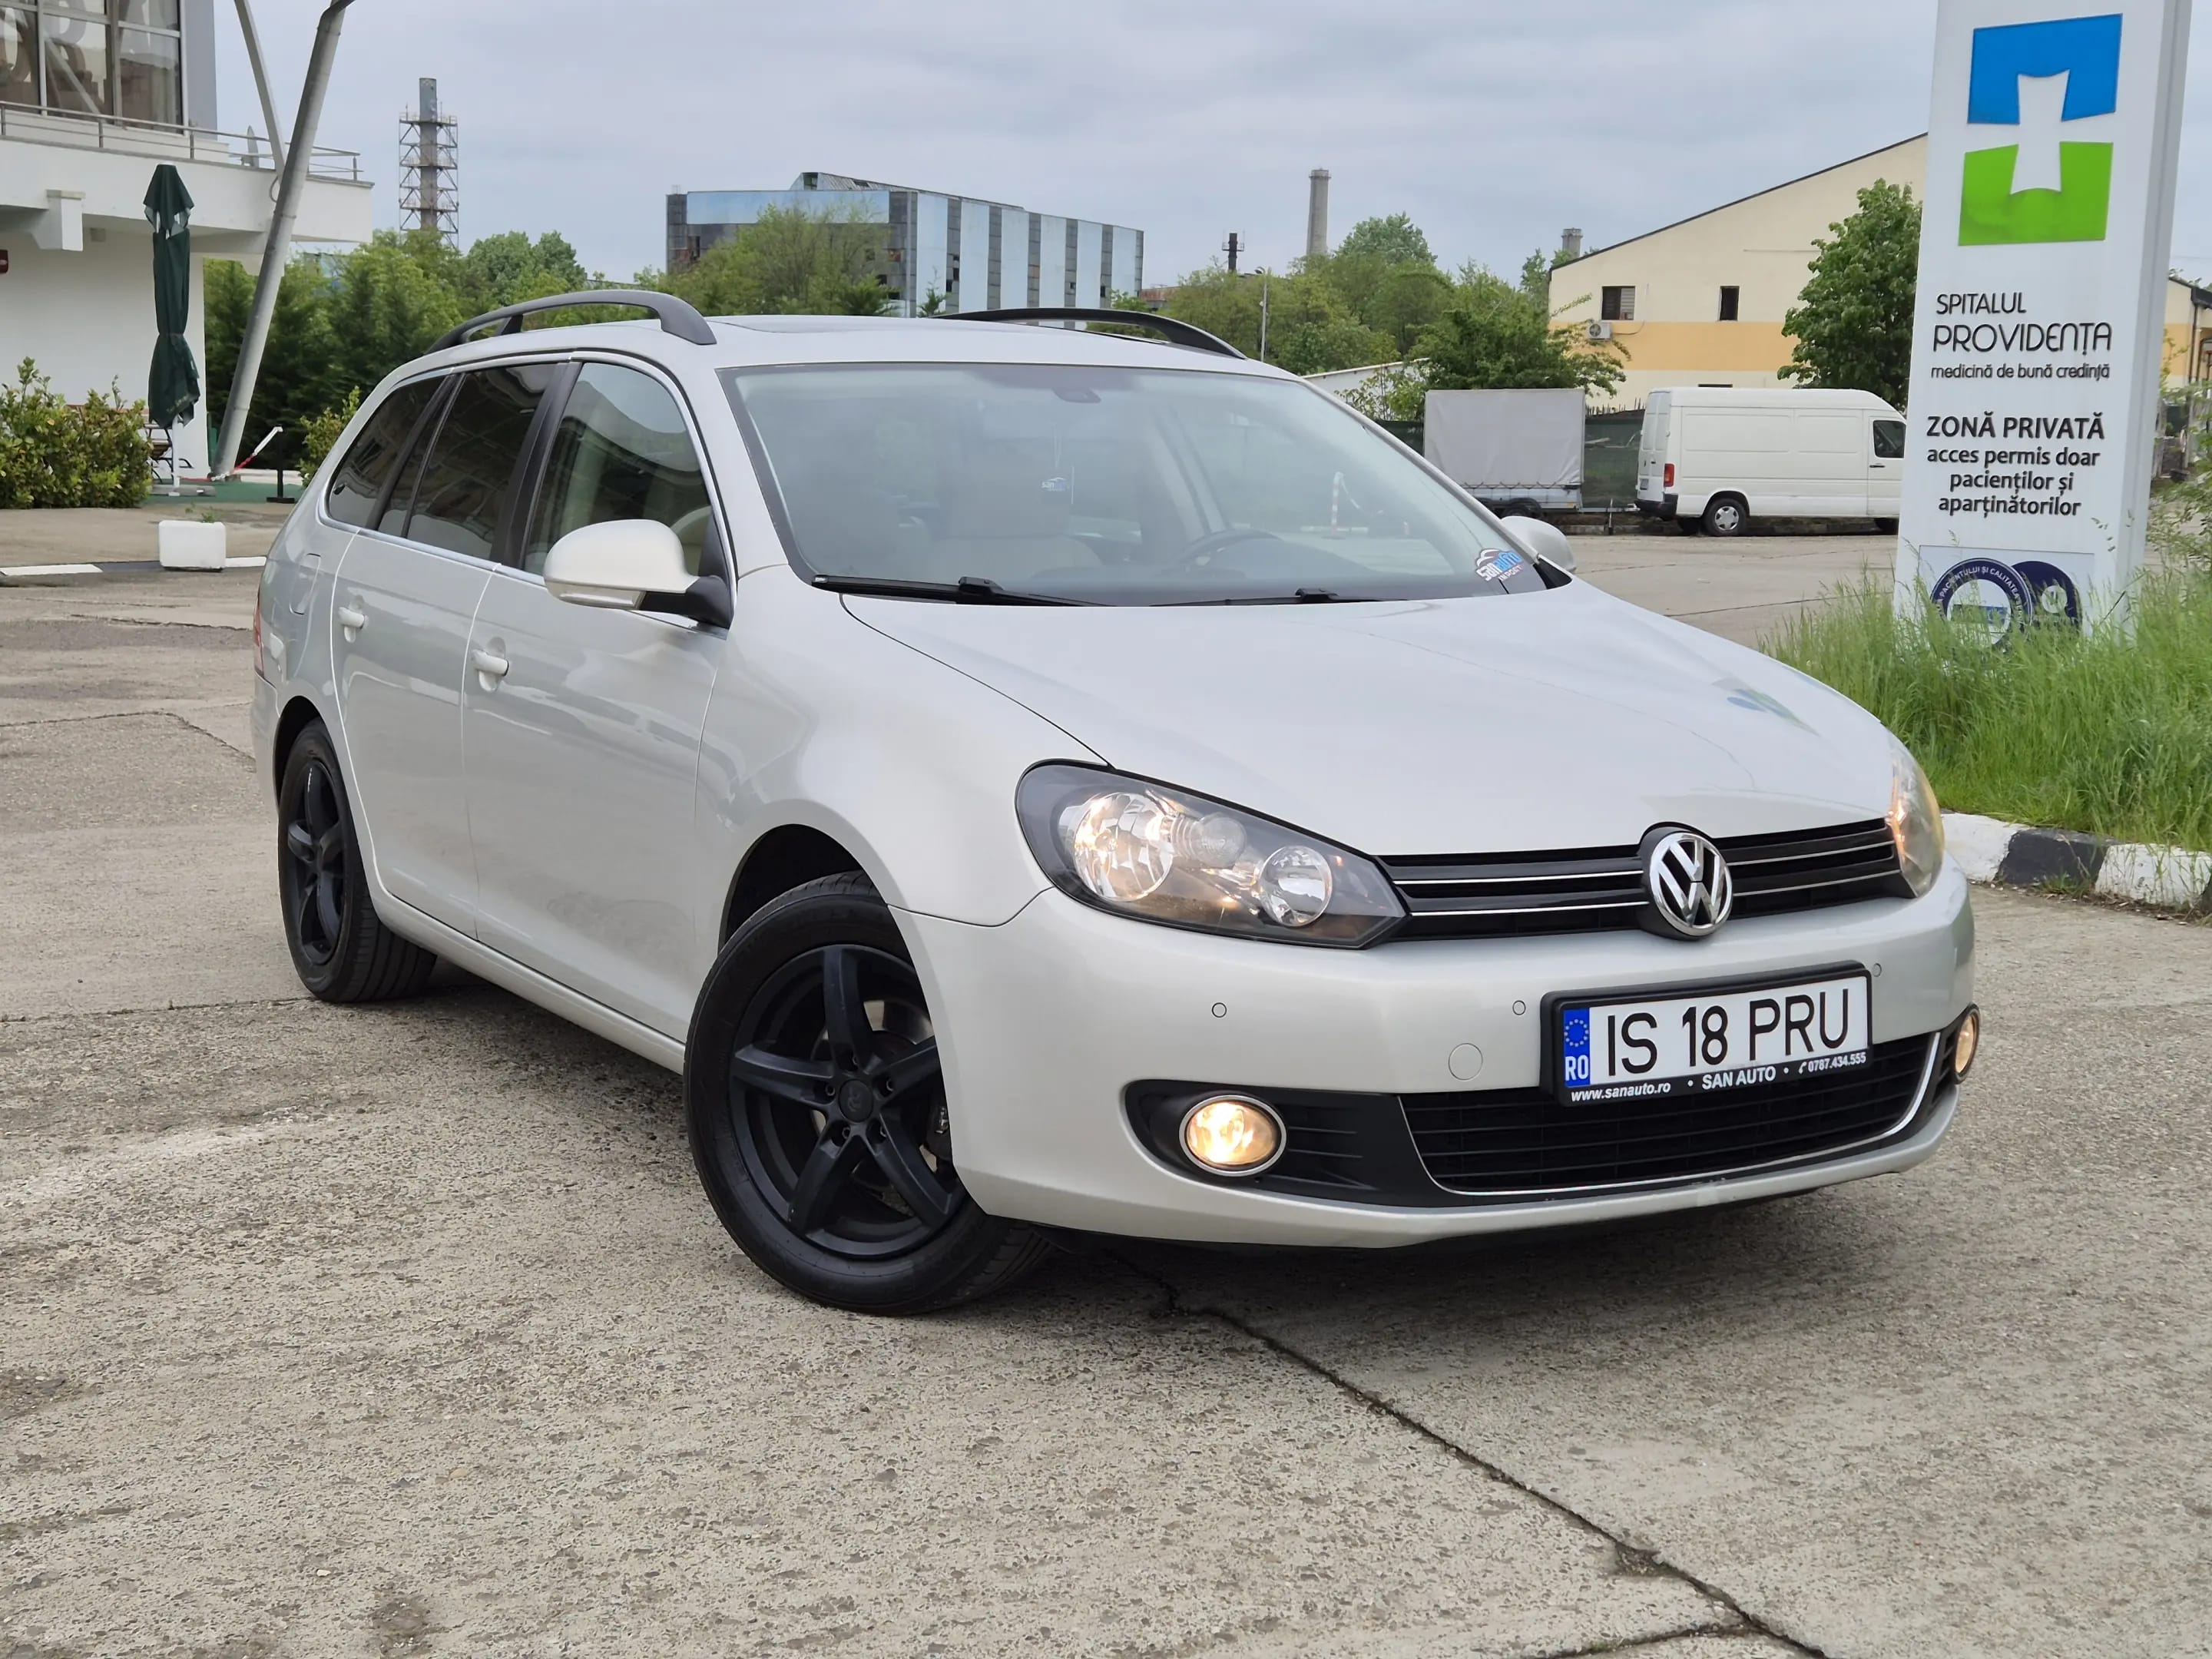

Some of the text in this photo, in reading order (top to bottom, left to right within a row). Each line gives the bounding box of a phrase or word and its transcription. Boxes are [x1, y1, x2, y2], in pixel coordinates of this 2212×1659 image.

[1936, 292, 2027, 315] SPITALUL
[1932, 322, 2112, 356] PROVIDENȚA
[1930, 363, 1993, 379] medicină
[1996, 363, 2015, 378] de
[2017, 363, 2052, 379] bună
[1926, 411, 2105, 439] ZONĂ PRIVATĂ
[1927, 446, 2101, 469] acces permis doar
[1949, 470, 2075, 496] pacienților și
[1938, 495, 2082, 518] aparținătorilor
[1608, 988, 1849, 1076] IS 18 PRU
[1565, 1055, 1589, 1081] RO
[1808, 1051, 1866, 1072] 0787.434.555
[1702, 1066, 1777, 1090] SAN AUTO
[1571, 1082, 1671, 1102] www.sanauto.ro
